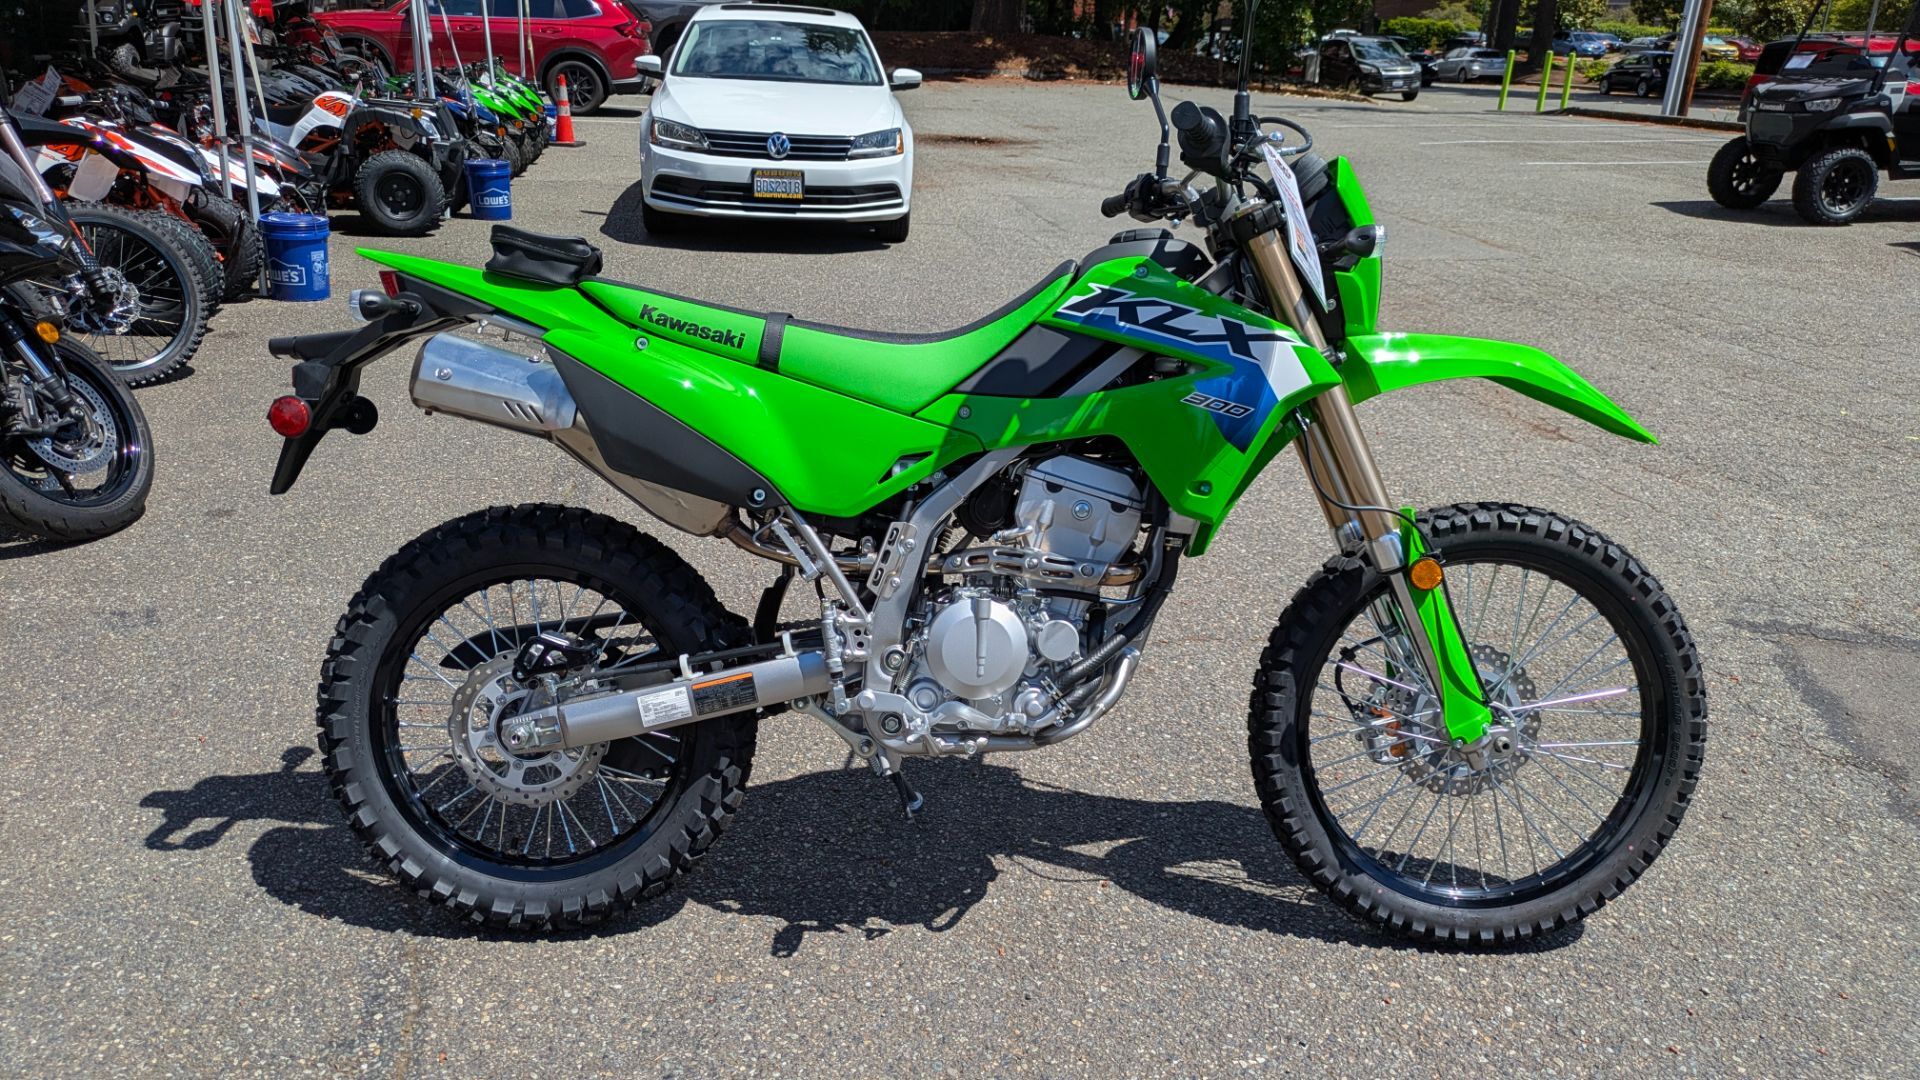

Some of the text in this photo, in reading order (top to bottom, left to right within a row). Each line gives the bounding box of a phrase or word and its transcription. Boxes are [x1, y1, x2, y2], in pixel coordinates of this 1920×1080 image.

[1759, 102, 1785, 111] Kawasaki
[478, 194, 509, 205] LOWE'S
[271, 268, 300, 282] WE'S
[639, 303, 746, 349] Kawasaki
[1057, 283, 1299, 363] KLX
[1180, 391, 1255, 419] 300
